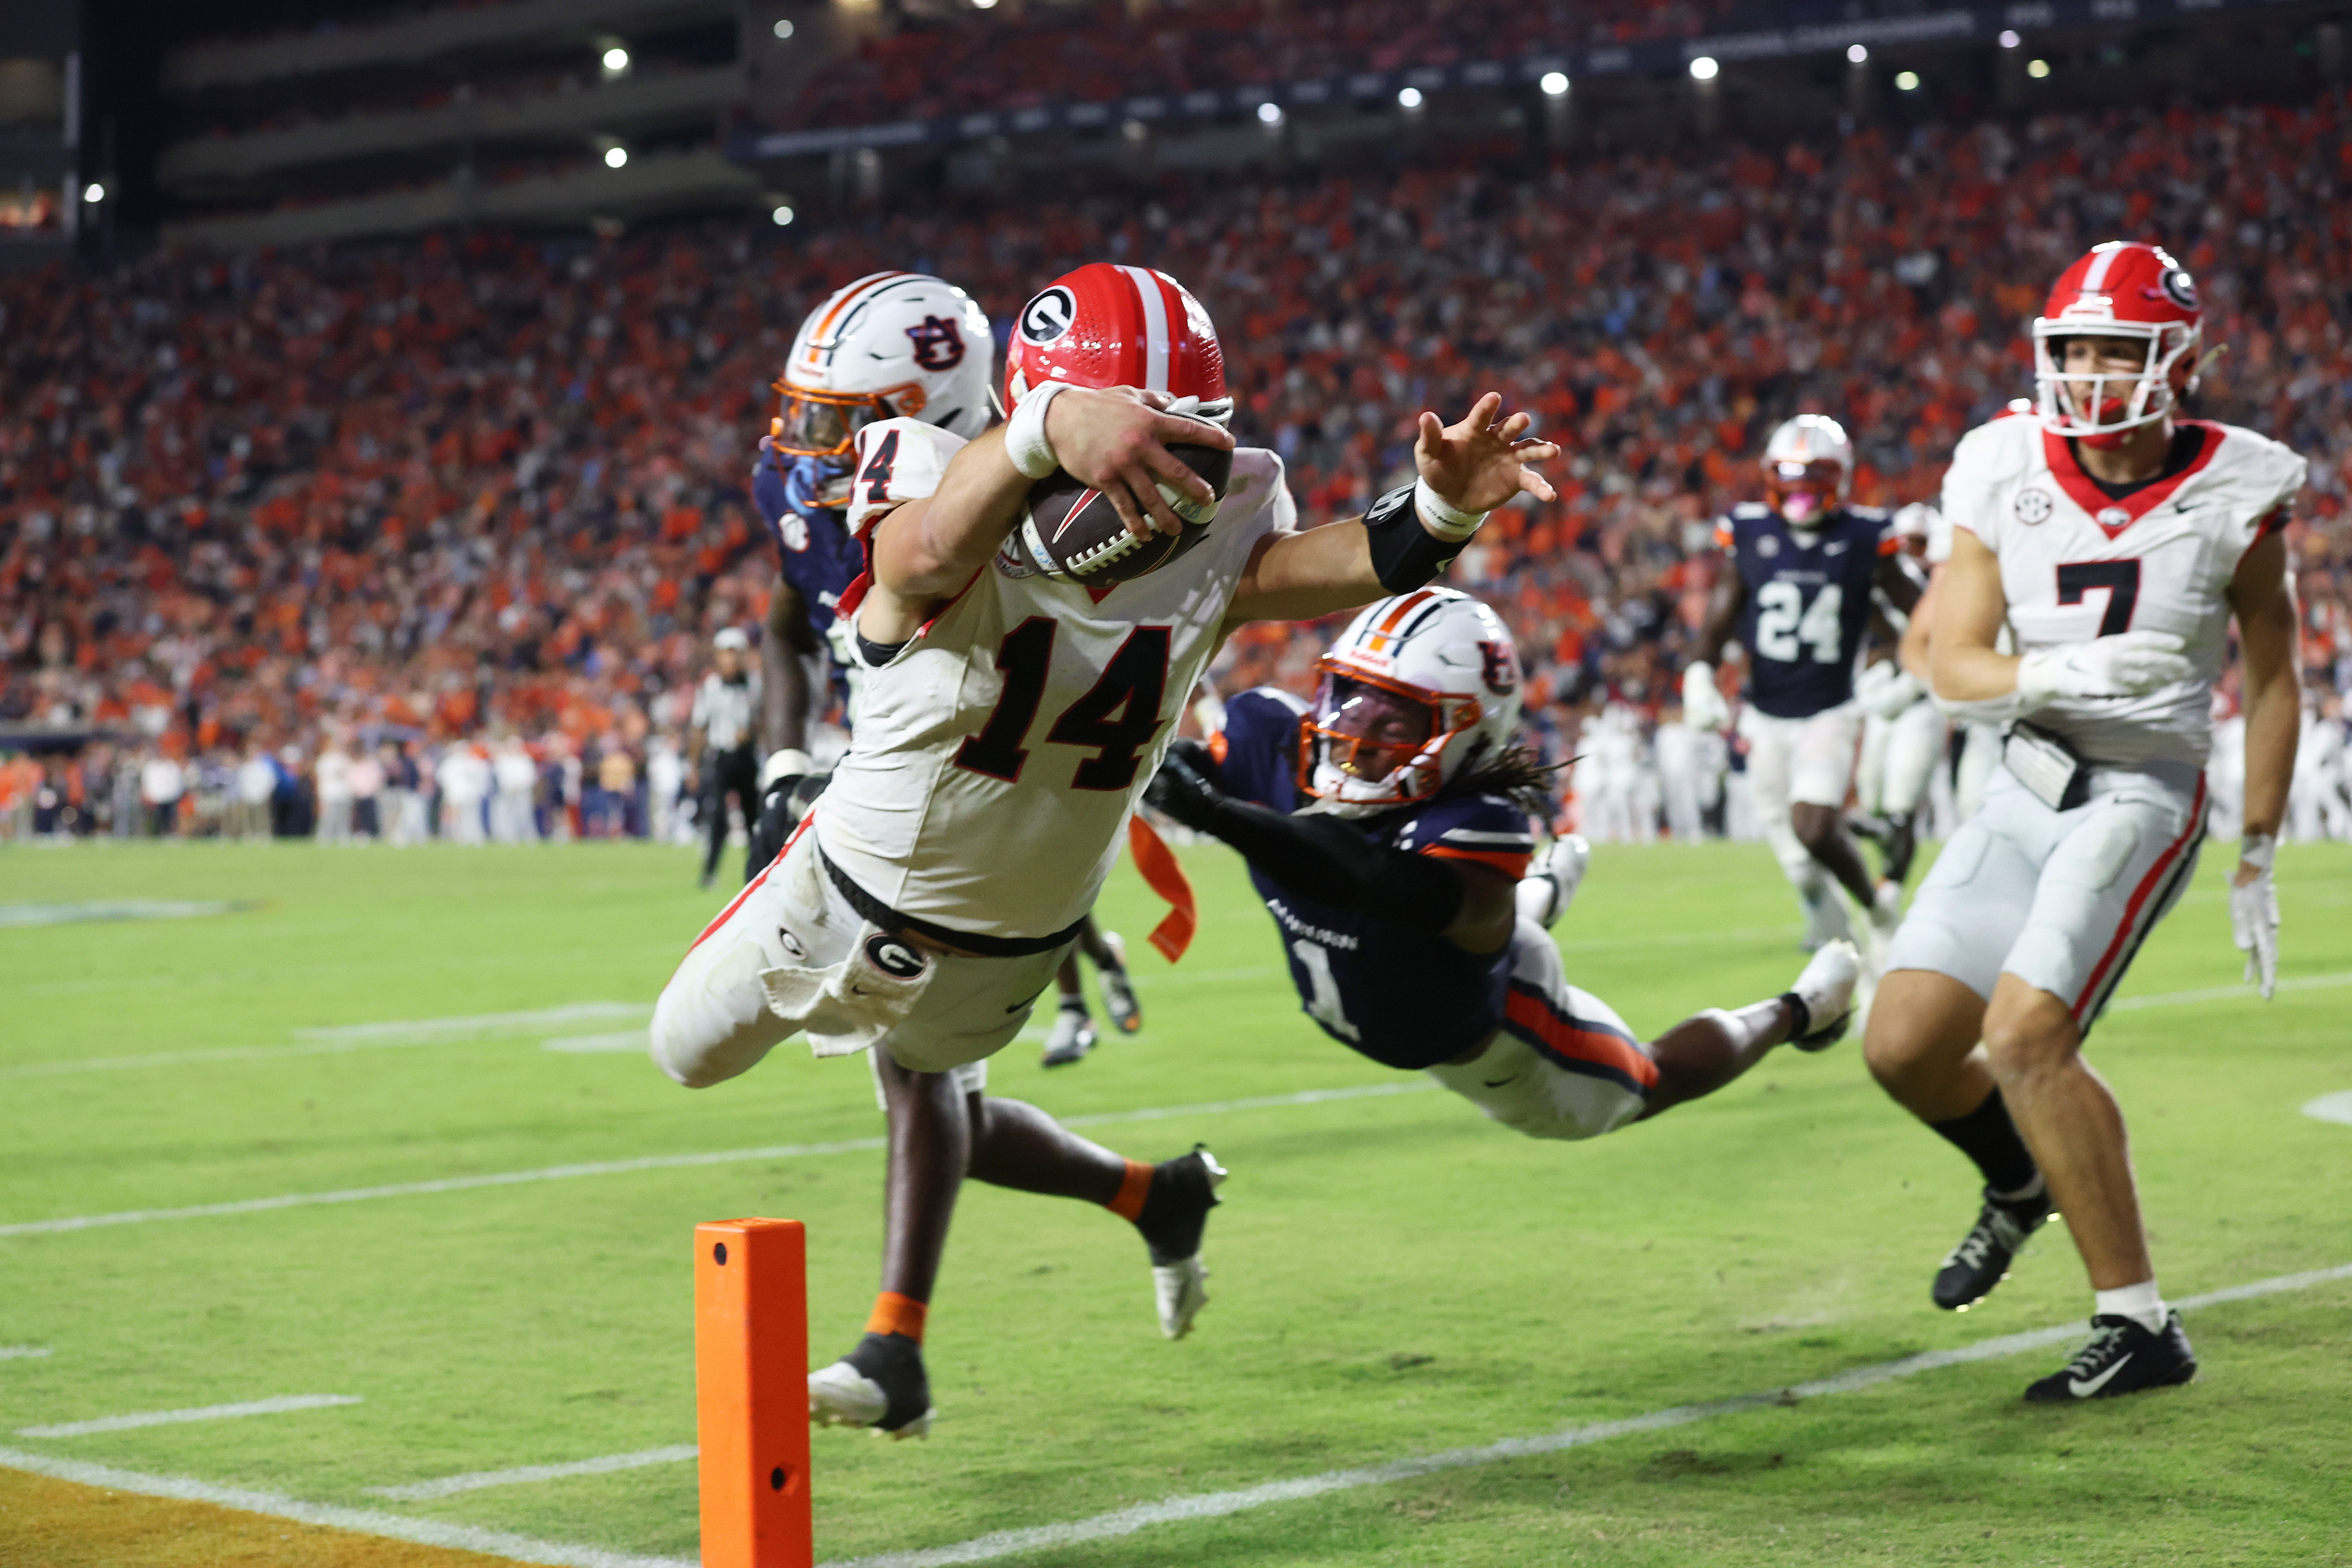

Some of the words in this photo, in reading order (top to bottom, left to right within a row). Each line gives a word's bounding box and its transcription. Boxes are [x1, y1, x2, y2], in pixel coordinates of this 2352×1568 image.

[1022, 289, 1071, 342] G
[1755, 582, 1843, 664] 24
[2057, 557, 2142, 638] 7
[954, 616, 1172, 791] 14
[877, 940, 926, 972] G
[1293, 938, 1362, 1042] 1
